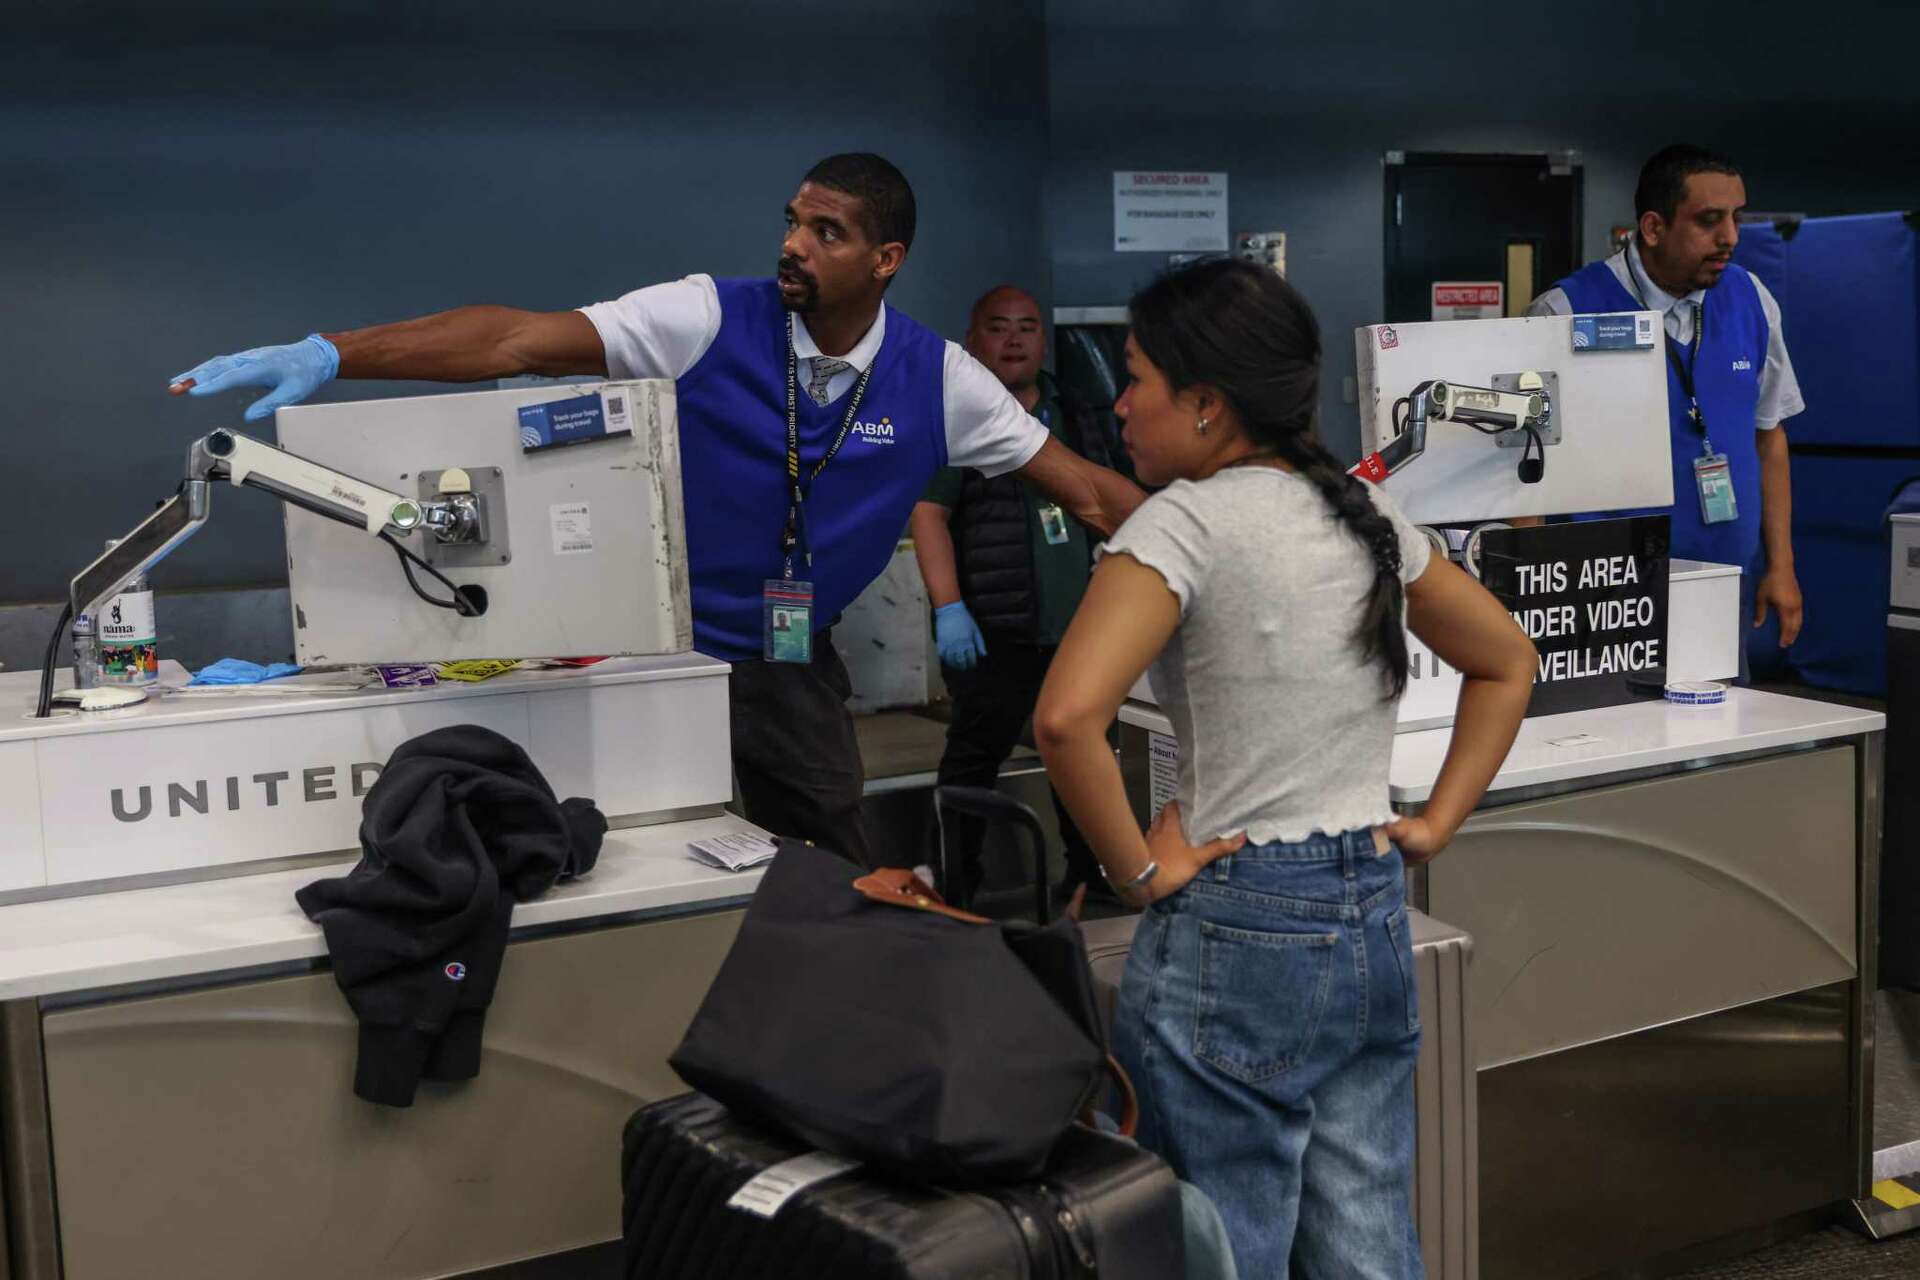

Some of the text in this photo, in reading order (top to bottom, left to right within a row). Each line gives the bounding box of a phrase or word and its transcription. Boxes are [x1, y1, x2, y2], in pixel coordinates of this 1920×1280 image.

[788, 388, 796, 410] FIRST
[851, 420, 894, 437] ABM
[1515, 555, 1638, 596] THIS AREA
[1509, 596, 1654, 639] NDER VIDEO
[1533, 639, 1660, 684] VEILLANCE
[110, 761, 386, 823] UNITED
